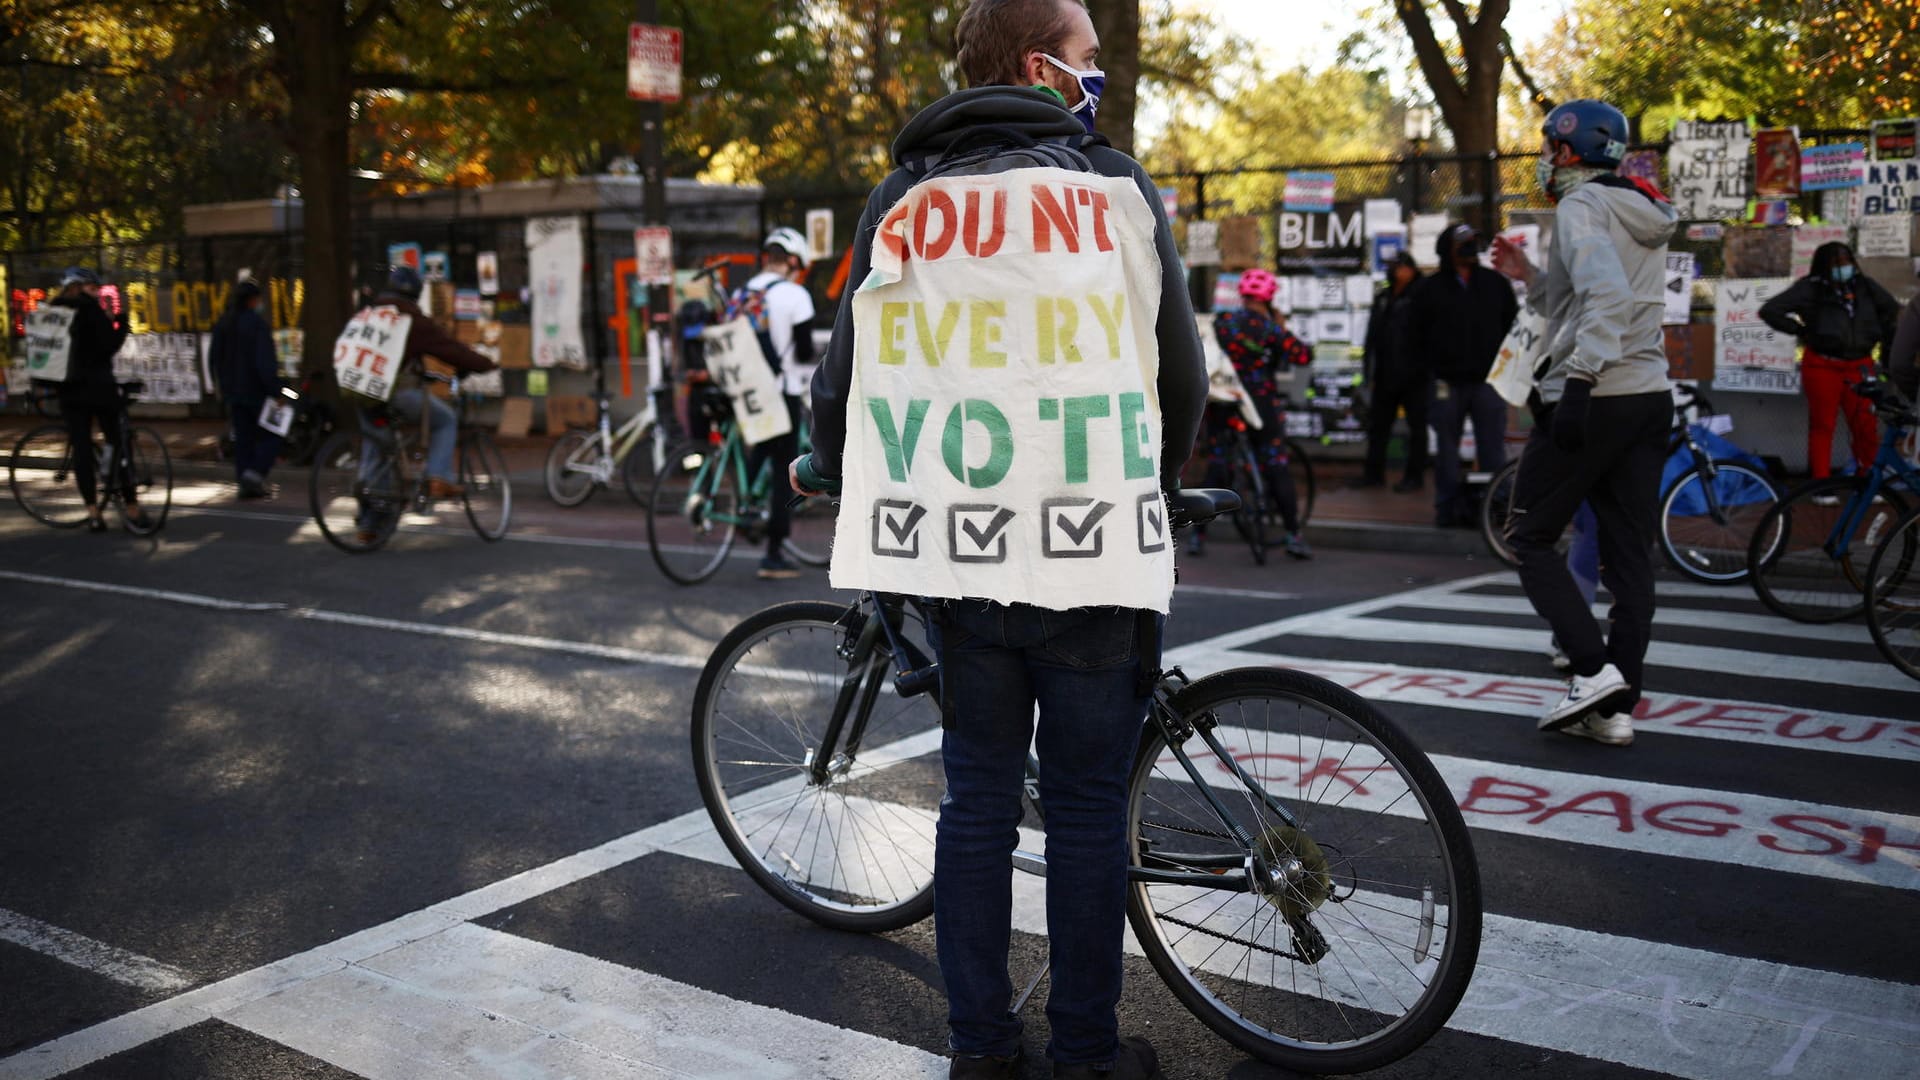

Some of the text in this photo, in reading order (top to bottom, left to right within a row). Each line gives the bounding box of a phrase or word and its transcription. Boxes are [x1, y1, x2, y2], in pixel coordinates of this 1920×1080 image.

[1279, 211, 1362, 249] BLM
[127, 279, 231, 334] BLACK
[1727, 285, 1768, 303] WE
[879, 293, 1124, 368] EVERY
[867, 392, 1156, 489] VOTE
